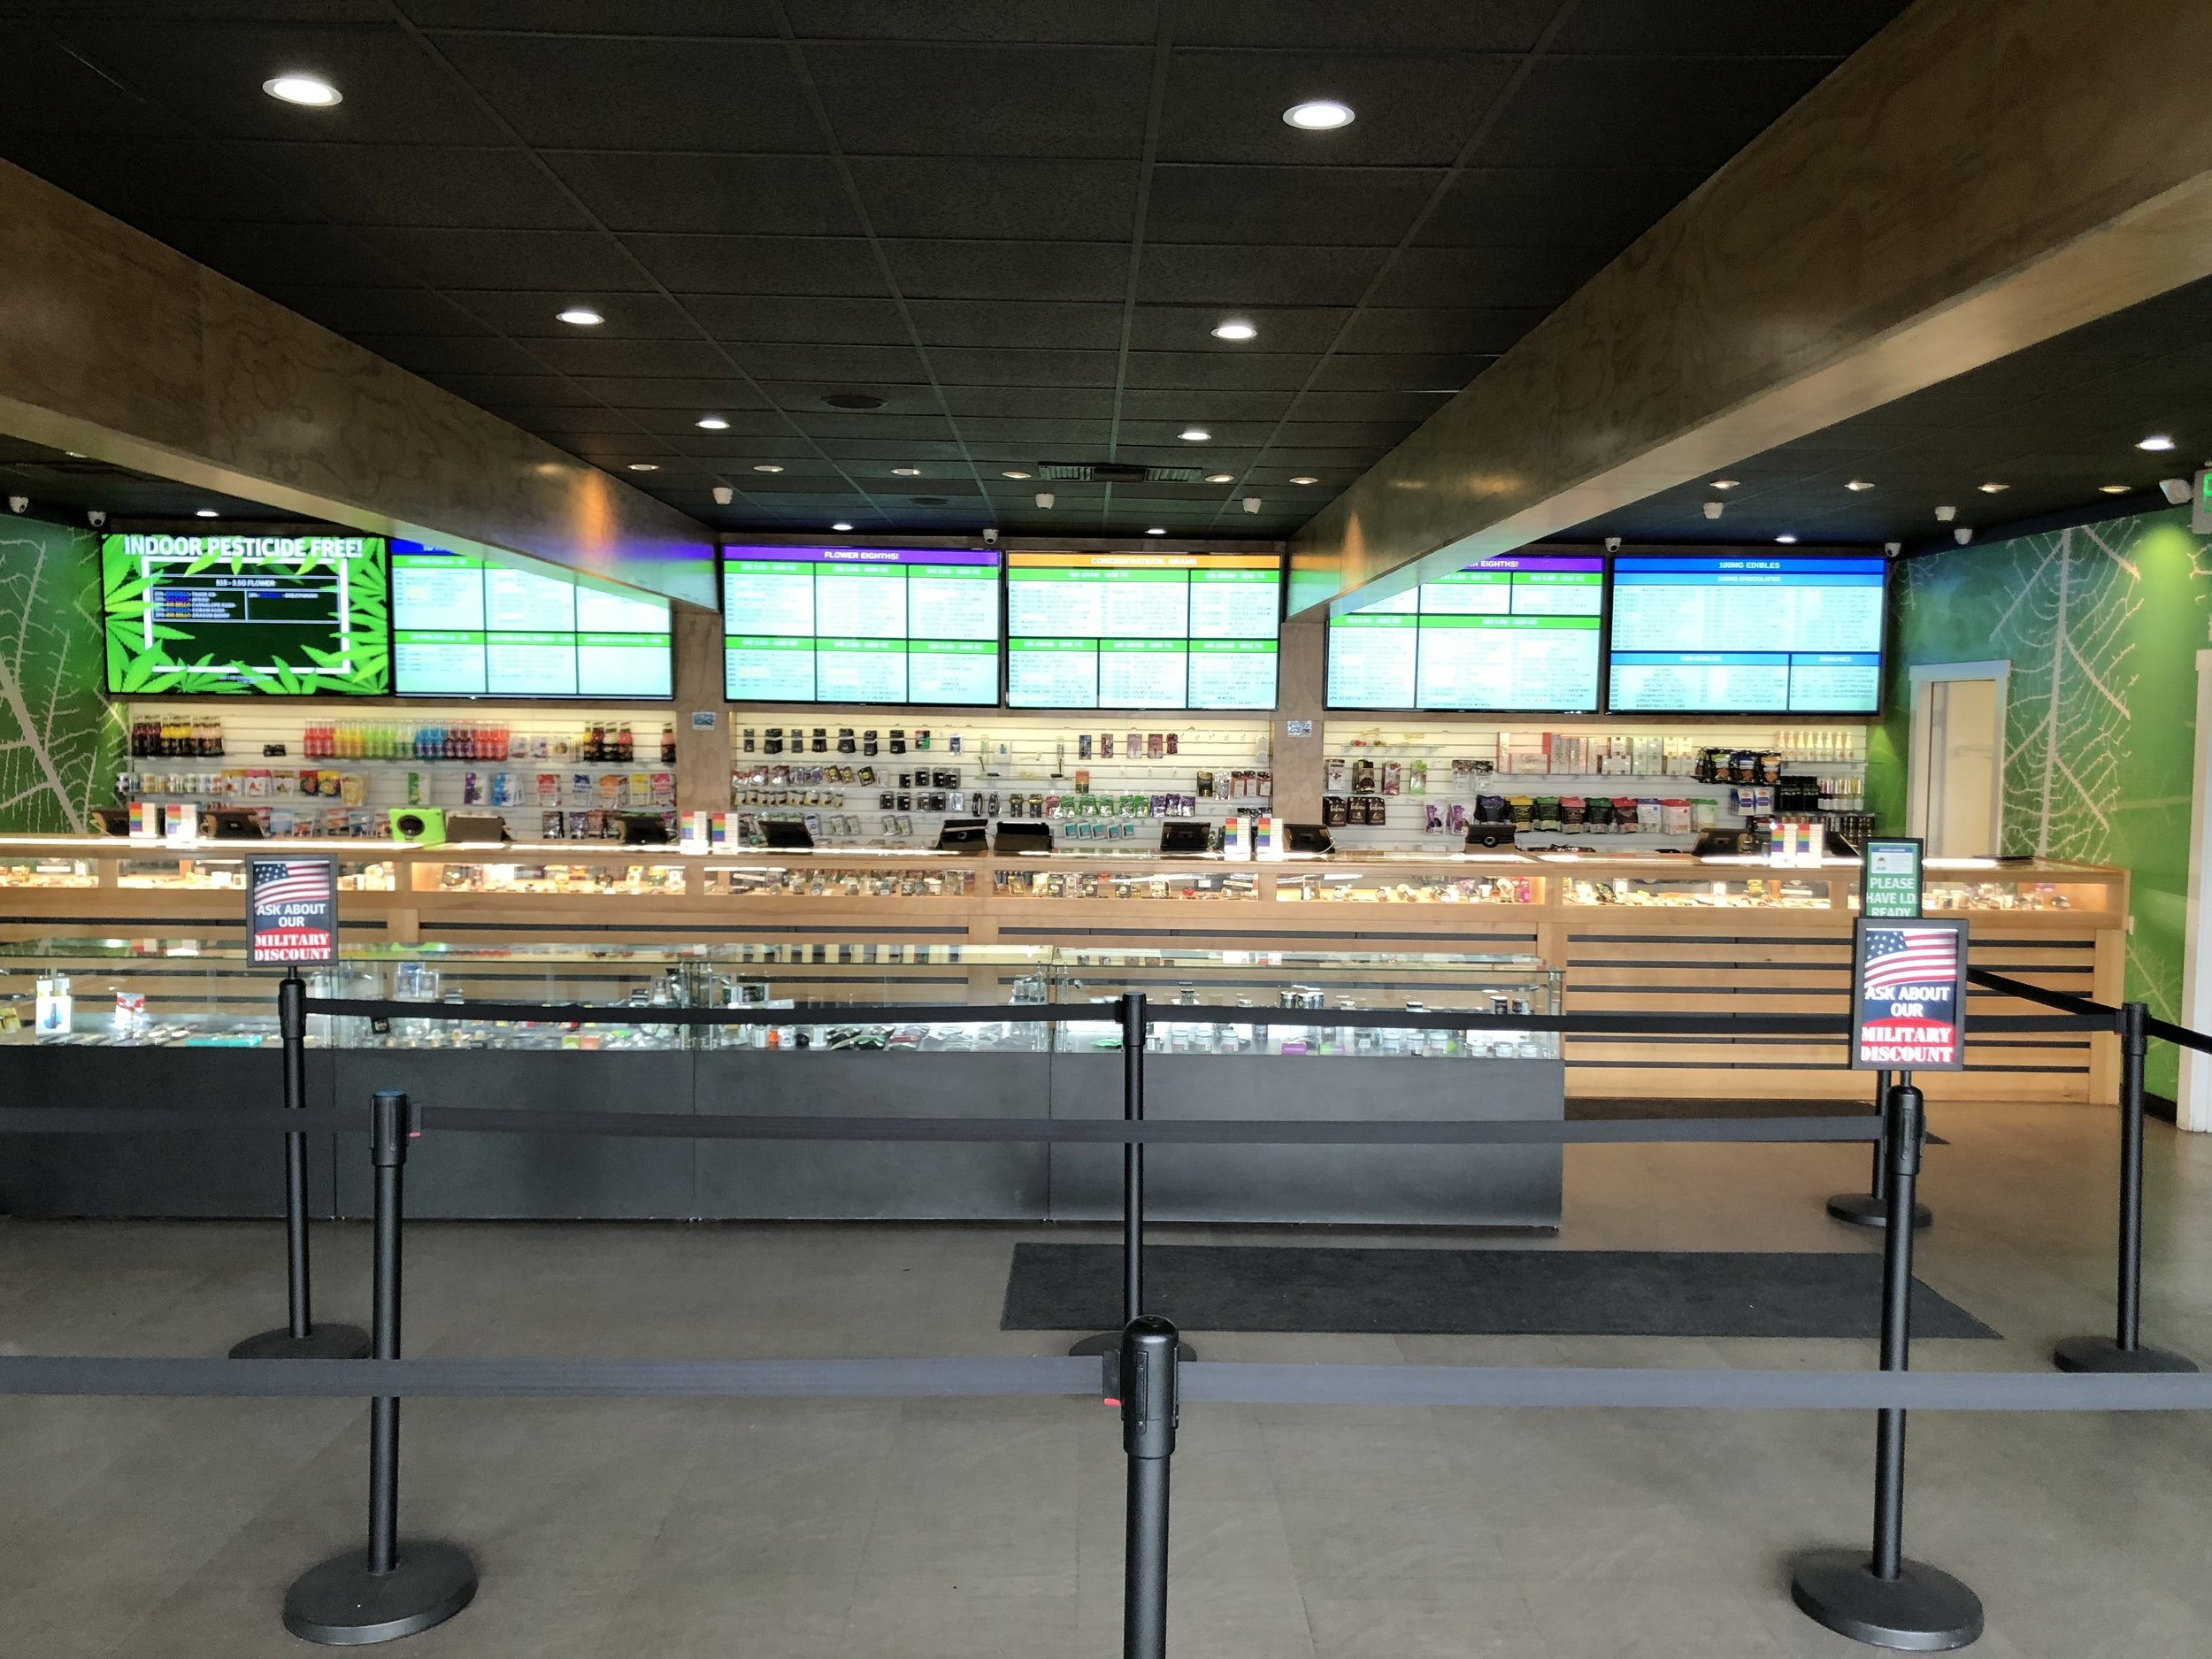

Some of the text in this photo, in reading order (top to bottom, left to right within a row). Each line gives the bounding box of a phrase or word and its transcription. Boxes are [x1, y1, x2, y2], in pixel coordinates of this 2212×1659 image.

[125, 536, 363, 558] INDOOR PESTICIDE FREE!
[1870, 877, 1915, 889] PLEASE
[1866, 892, 1896, 904] HAVE
[257, 903, 326, 916] ASK ABOUT
[1871, 907, 1912, 917] READY
[278, 917, 305, 927] OUR
[255, 933, 329, 947] MILITARY
[254, 948, 331, 962] DISCOUNT
[1864, 986, 1950, 1002] ASK ABOUT
[1890, 1002, 1923, 1018] OUR
[1862, 1026, 1952, 1043] MILITARY
[1861, 1046, 1954, 1063] DISCOUNT
